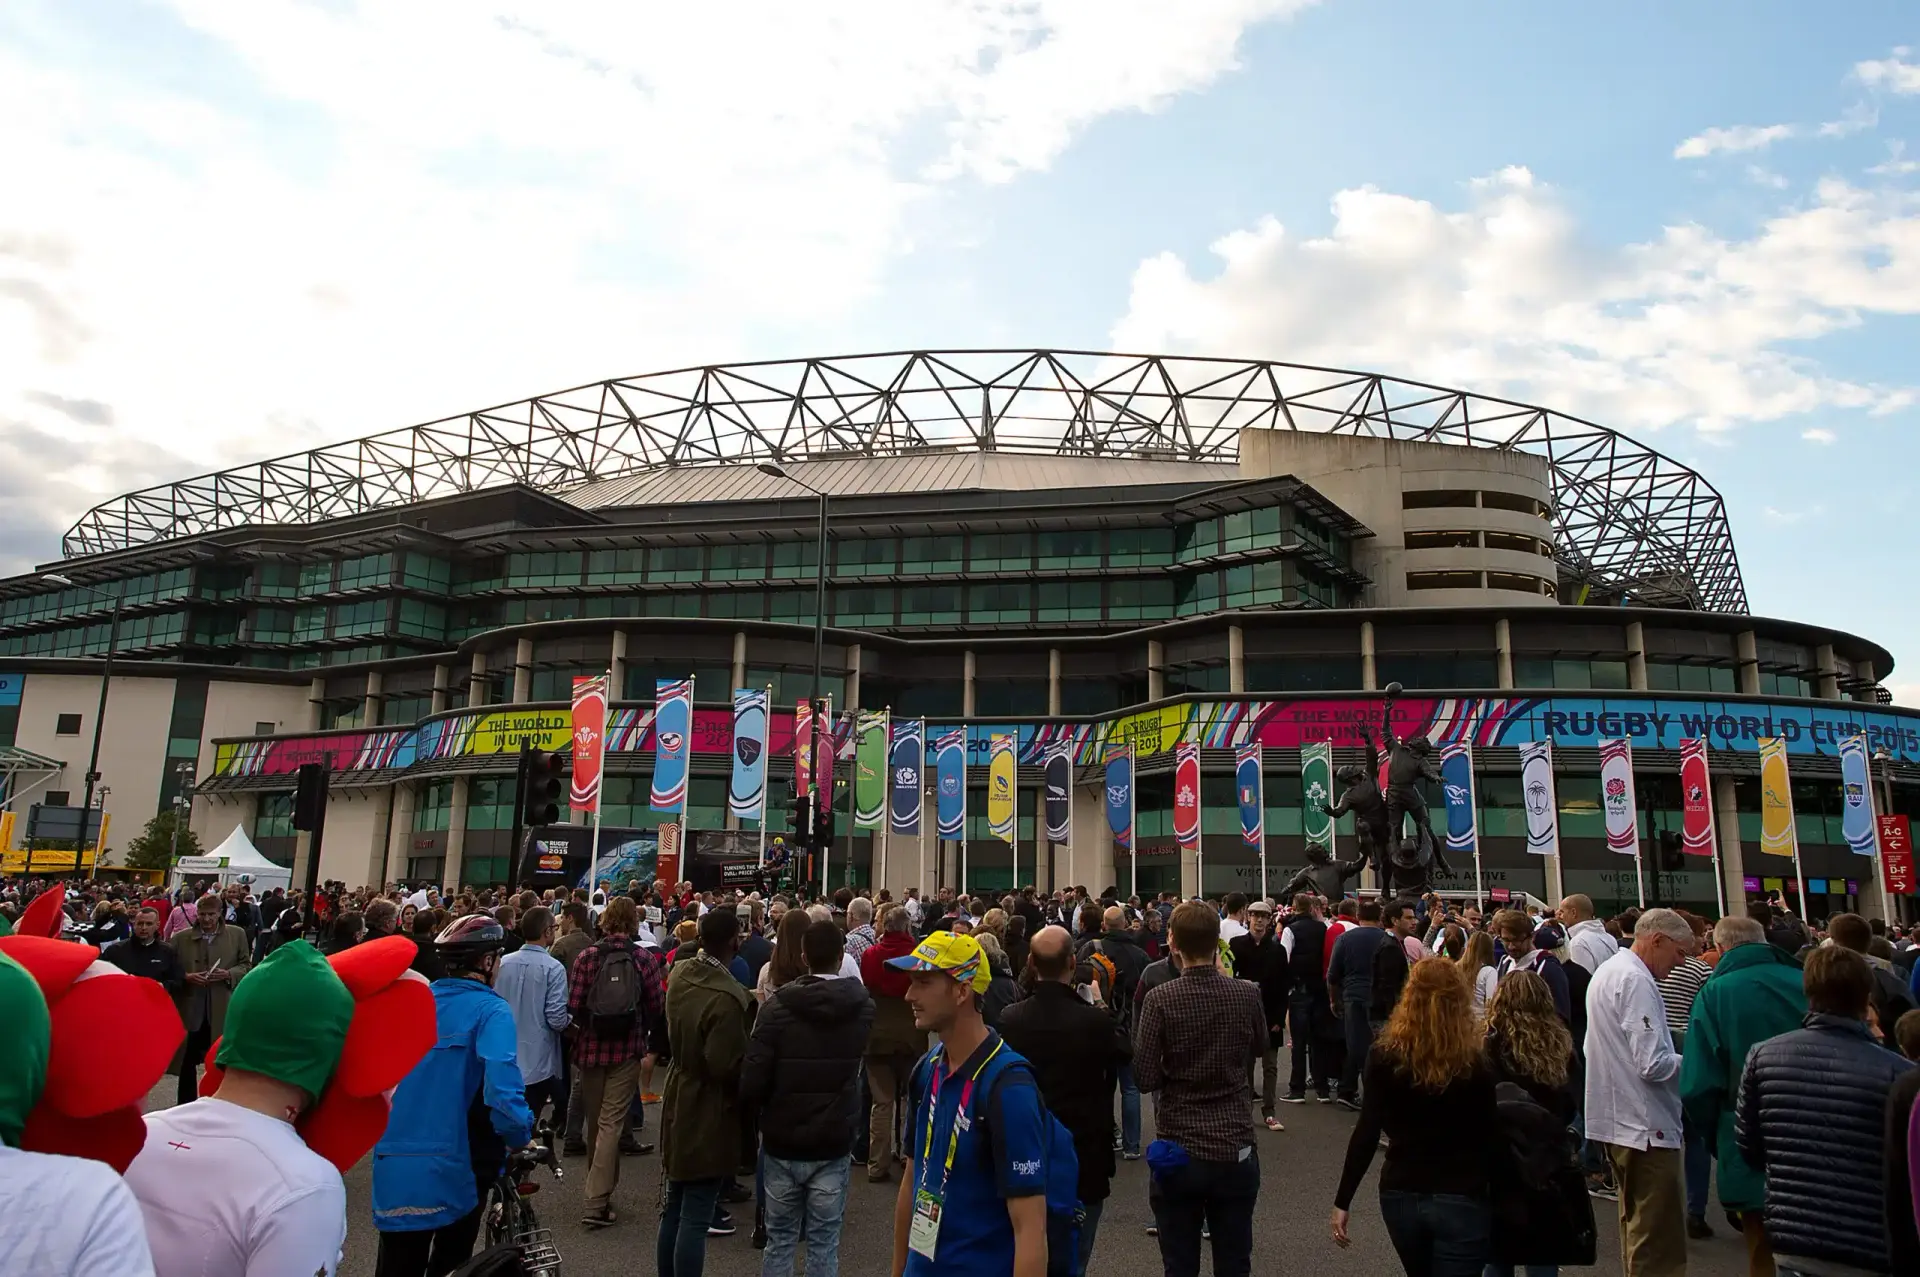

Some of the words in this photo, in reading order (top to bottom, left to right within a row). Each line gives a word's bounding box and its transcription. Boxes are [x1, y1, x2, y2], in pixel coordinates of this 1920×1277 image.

[1291, 709, 1330, 723] THE
[1333, 709, 1408, 722] WORD
[488, 720, 510, 732] THE
[513, 717, 564, 731] WORLD
[1139, 716, 1162, 731] RUGBY
[1304, 726, 1326, 739] IN
[1543, 711, 1671, 738] RUGBY
[1679, 713, 1801, 743] WORLD
[1868, 724, 1919, 753] 2015
[494, 734, 506, 746] IN
[1884, 827, 1902, 836] A-C
[1890, 866, 1907, 874] D-F
[1650, 874, 1689, 885] CTIVE
[1012, 1159, 1041, 1170] England
